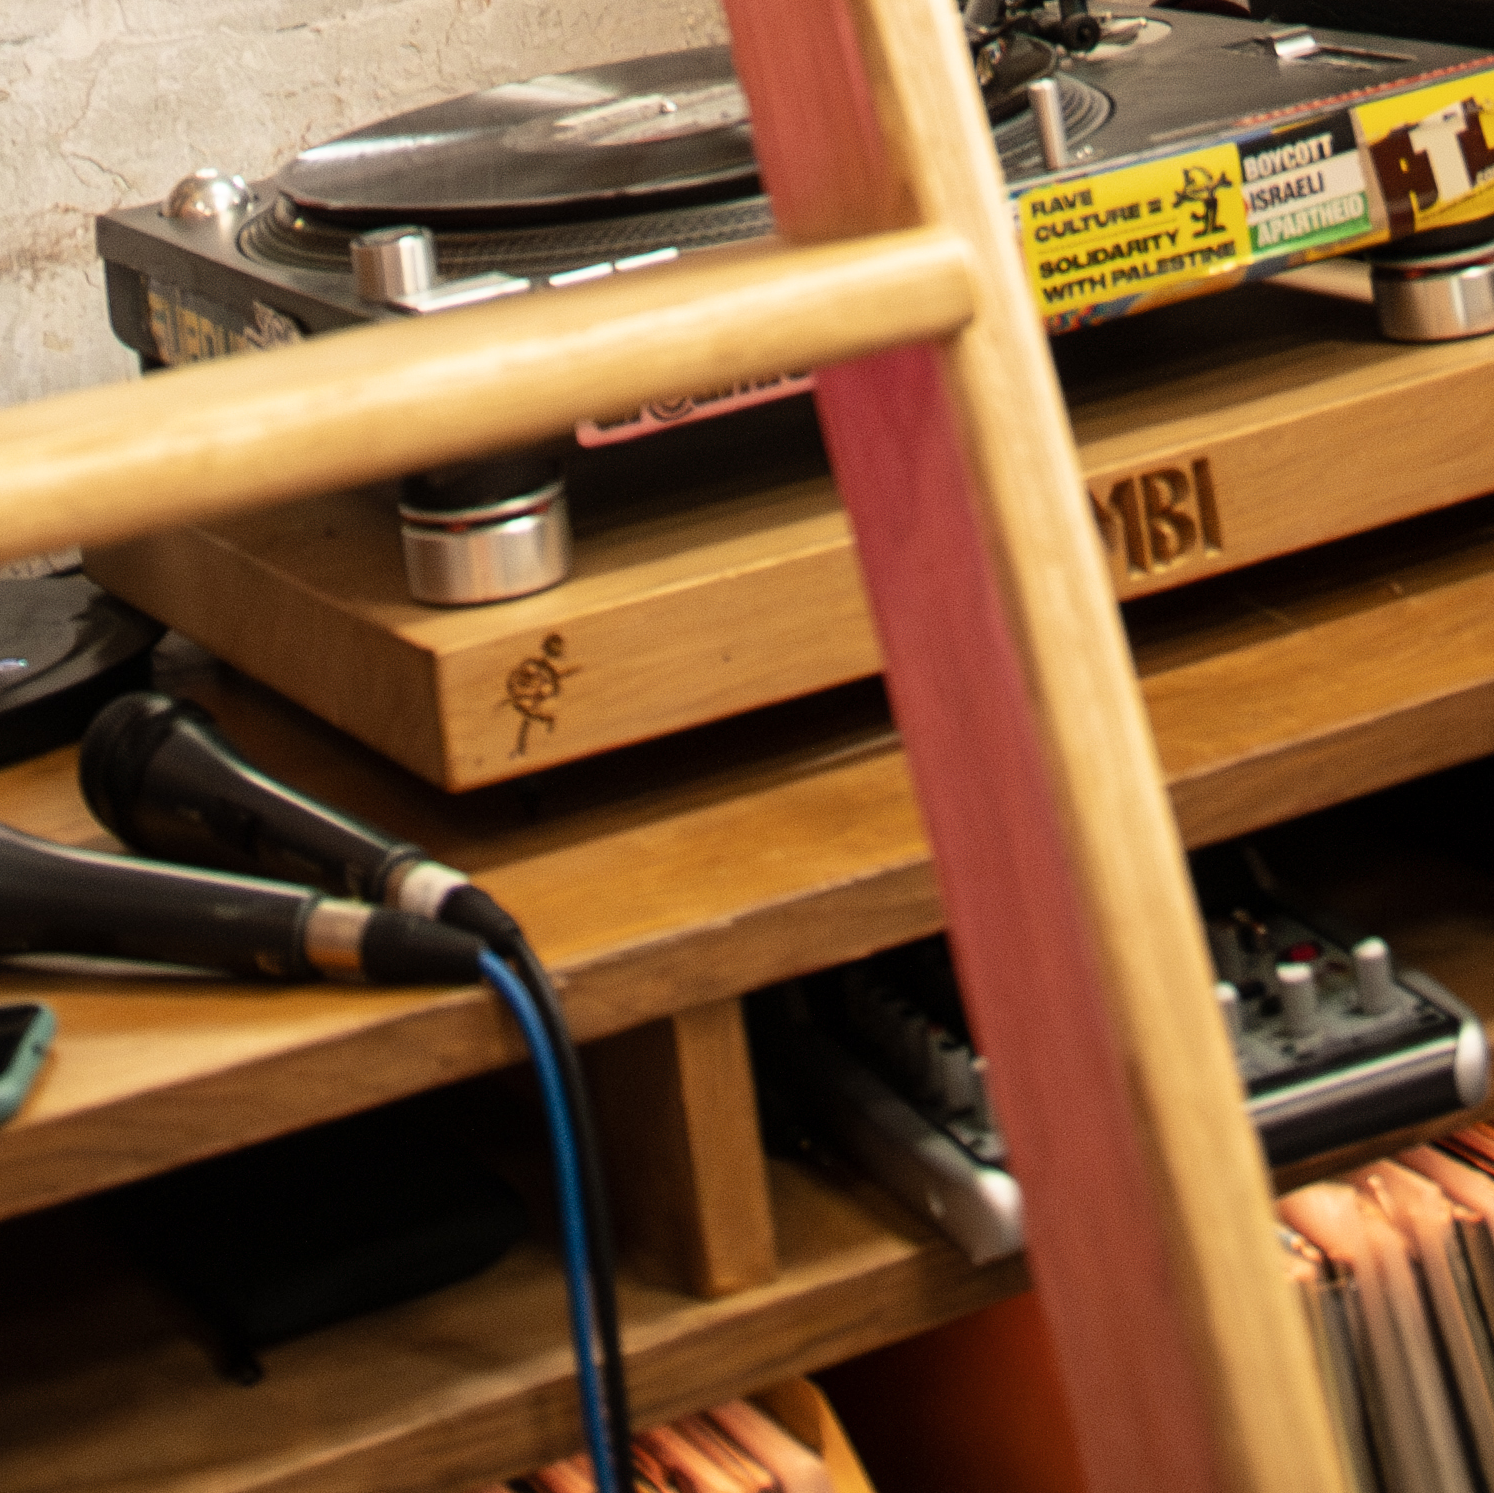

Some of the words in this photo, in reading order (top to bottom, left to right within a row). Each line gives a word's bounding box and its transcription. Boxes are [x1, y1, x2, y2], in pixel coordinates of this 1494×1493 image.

[1242, 131, 1333, 181] BOYCOTT
[1031, 188, 1093, 218] RAVE
[1250, 171, 1324, 212] ISRAELI
[1034, 203, 1141, 243] CULTURE
[1257, 194, 1365, 248] APARTHEID
[1039, 228, 1179, 279] SOLIDARITY
[1043, 273, 1107, 303] WITH
[1110, 240, 1237, 286] PALESTINE
